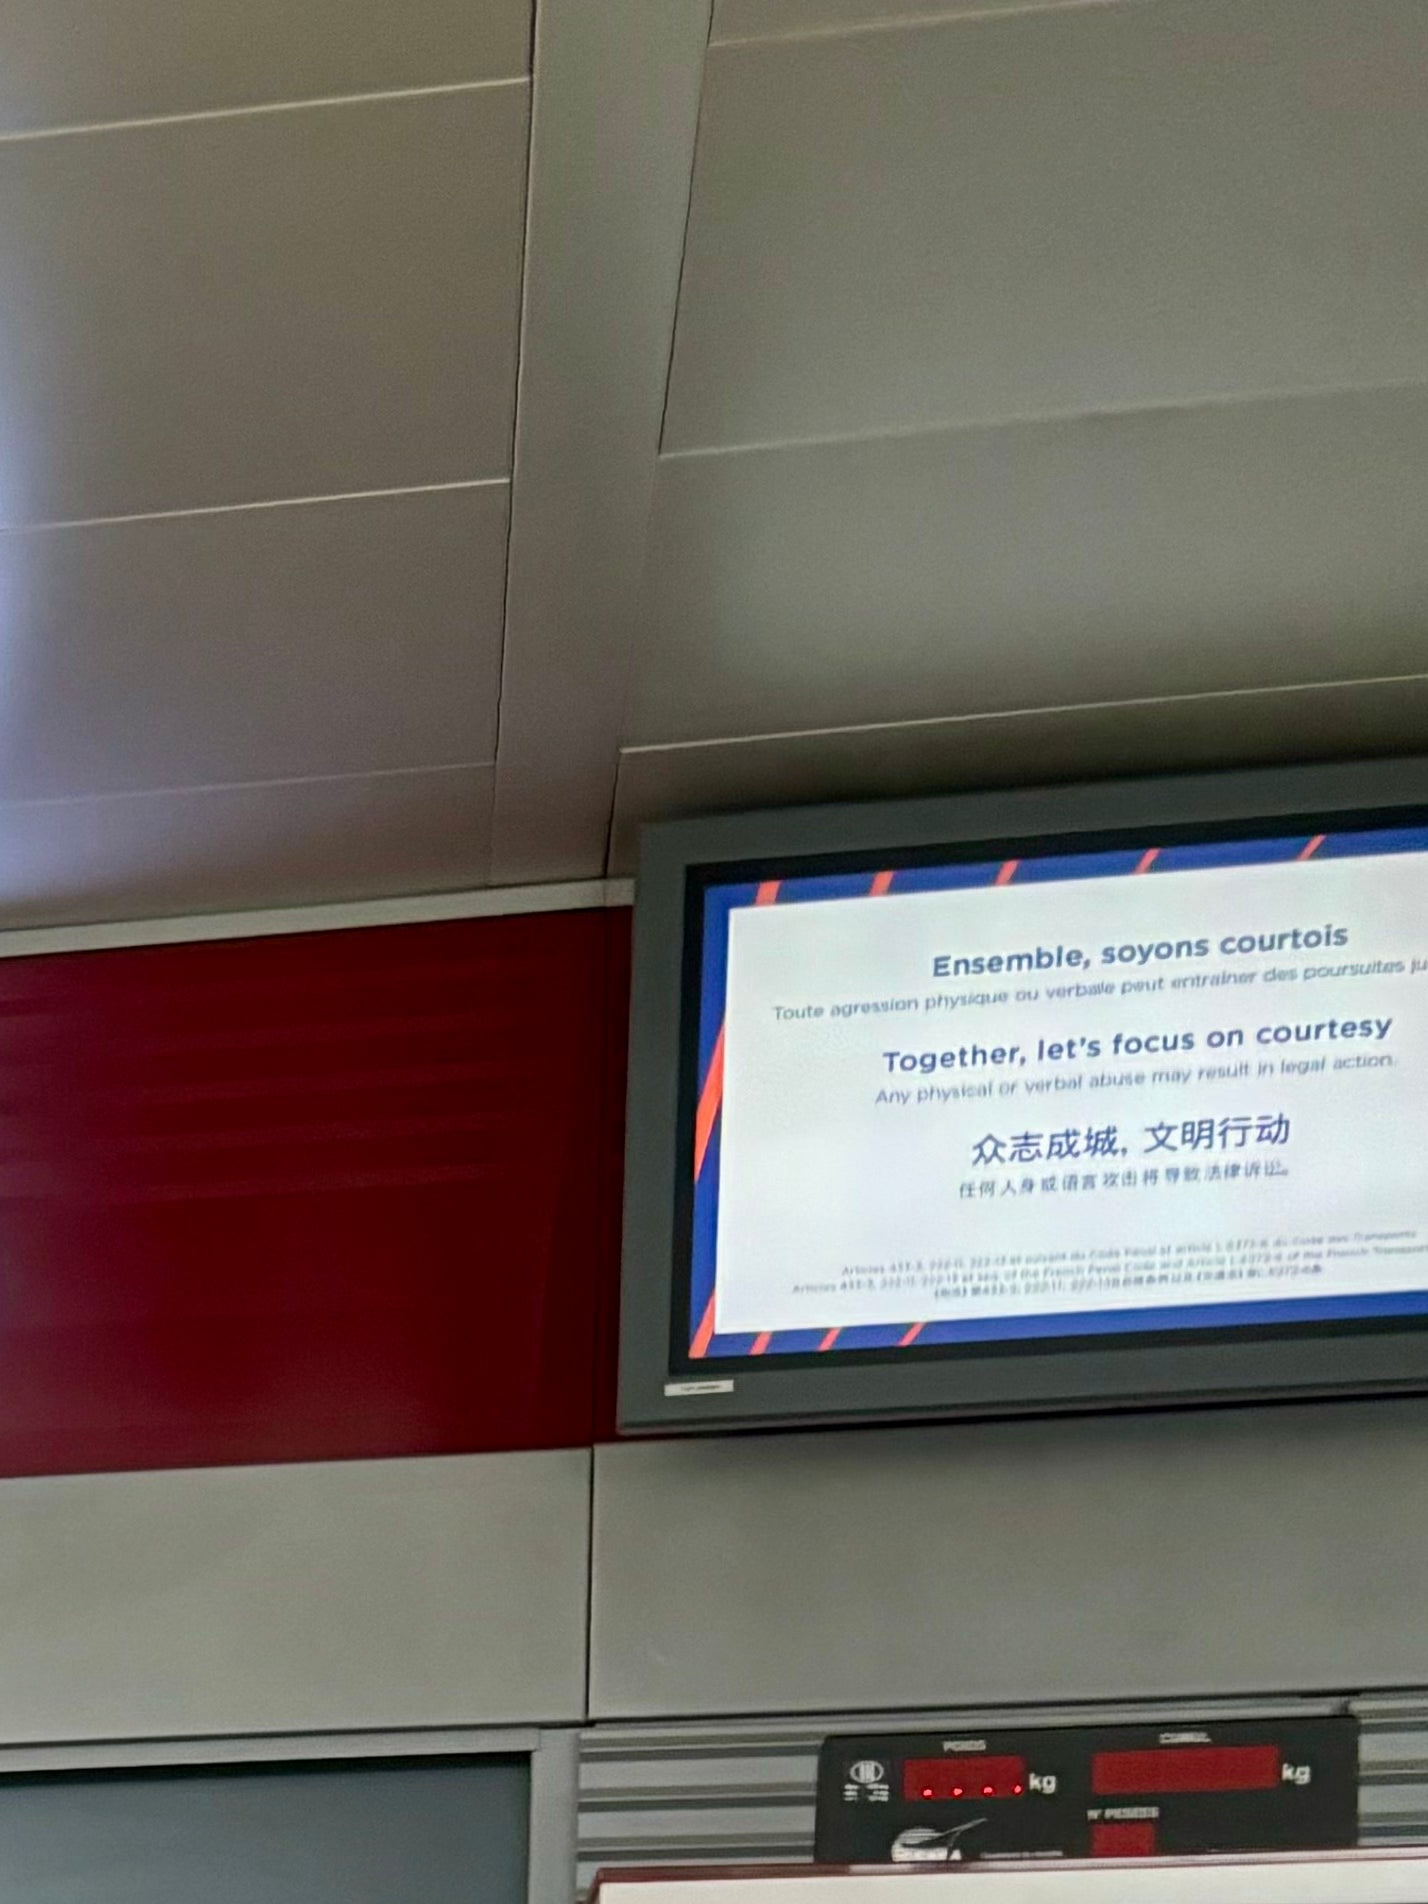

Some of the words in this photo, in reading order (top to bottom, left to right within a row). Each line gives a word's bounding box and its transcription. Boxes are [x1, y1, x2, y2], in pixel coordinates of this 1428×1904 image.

[933, 945, 1090, 977] Ensemble,
[1101, 937, 1210, 965] soyons
[1219, 924, 1348, 955] courtois
[773, 1003, 824, 1021] Toute
[830, 997, 918, 1018] agression
[924, 989, 1008, 1012] physique
[1015, 989, 1039, 1001] ou
[1045, 981, 1115, 998] verbale
[1121, 977, 1164, 996] peut
[1263, 967, 1298, 983] des
[1303, 958, 1404, 981] poursuites
[882, 1044, 1026, 1075] Together,
[1112, 1032, 1195, 1056] focus
[1207, 1028, 1244, 1048] on
[1256, 1018, 1393, 1045] courtesy
[876, 1089, 910, 1106] Any
[917, 1081, 993, 1104] physical
[999, 1081, 1016, 1095] or
[1026, 1074, 1082, 1093] verbal
[1089, 1071, 1146, 1089] abuse
[1152, 1068, 1192, 1086] may
[1198, 1063, 1249, 1081] result
[1258, 1061, 1274, 1077] in
[1281, 1056, 1326, 1076] legal
[1029, 1772, 1057, 1795] kg
[1281, 1762, 1311, 1785] kg
